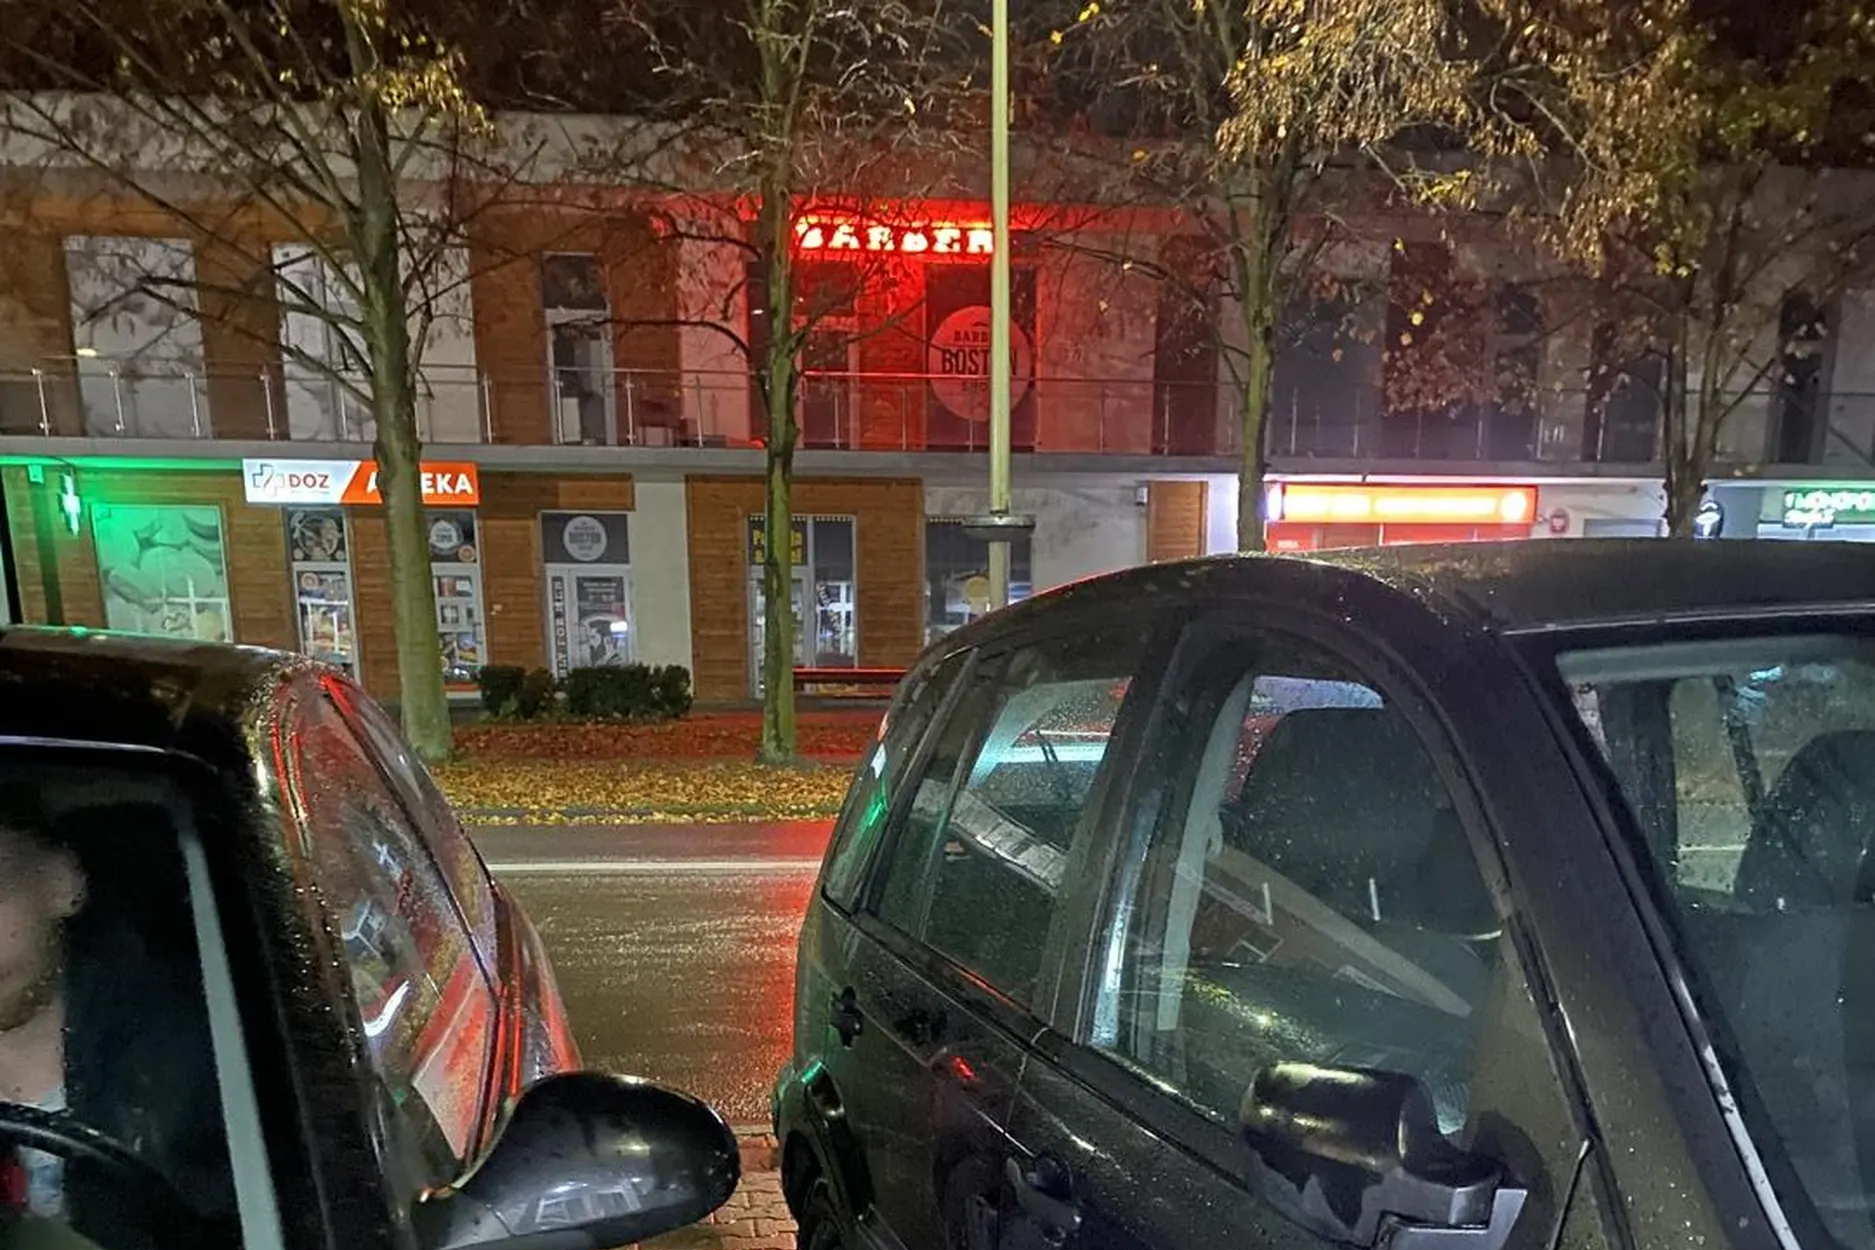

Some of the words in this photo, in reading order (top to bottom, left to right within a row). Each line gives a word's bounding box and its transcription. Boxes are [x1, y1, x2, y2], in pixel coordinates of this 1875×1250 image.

[796, 222, 993, 253] BARBER
[288, 473, 329, 489] DOZ
[366, 472, 473, 494] AEKA
